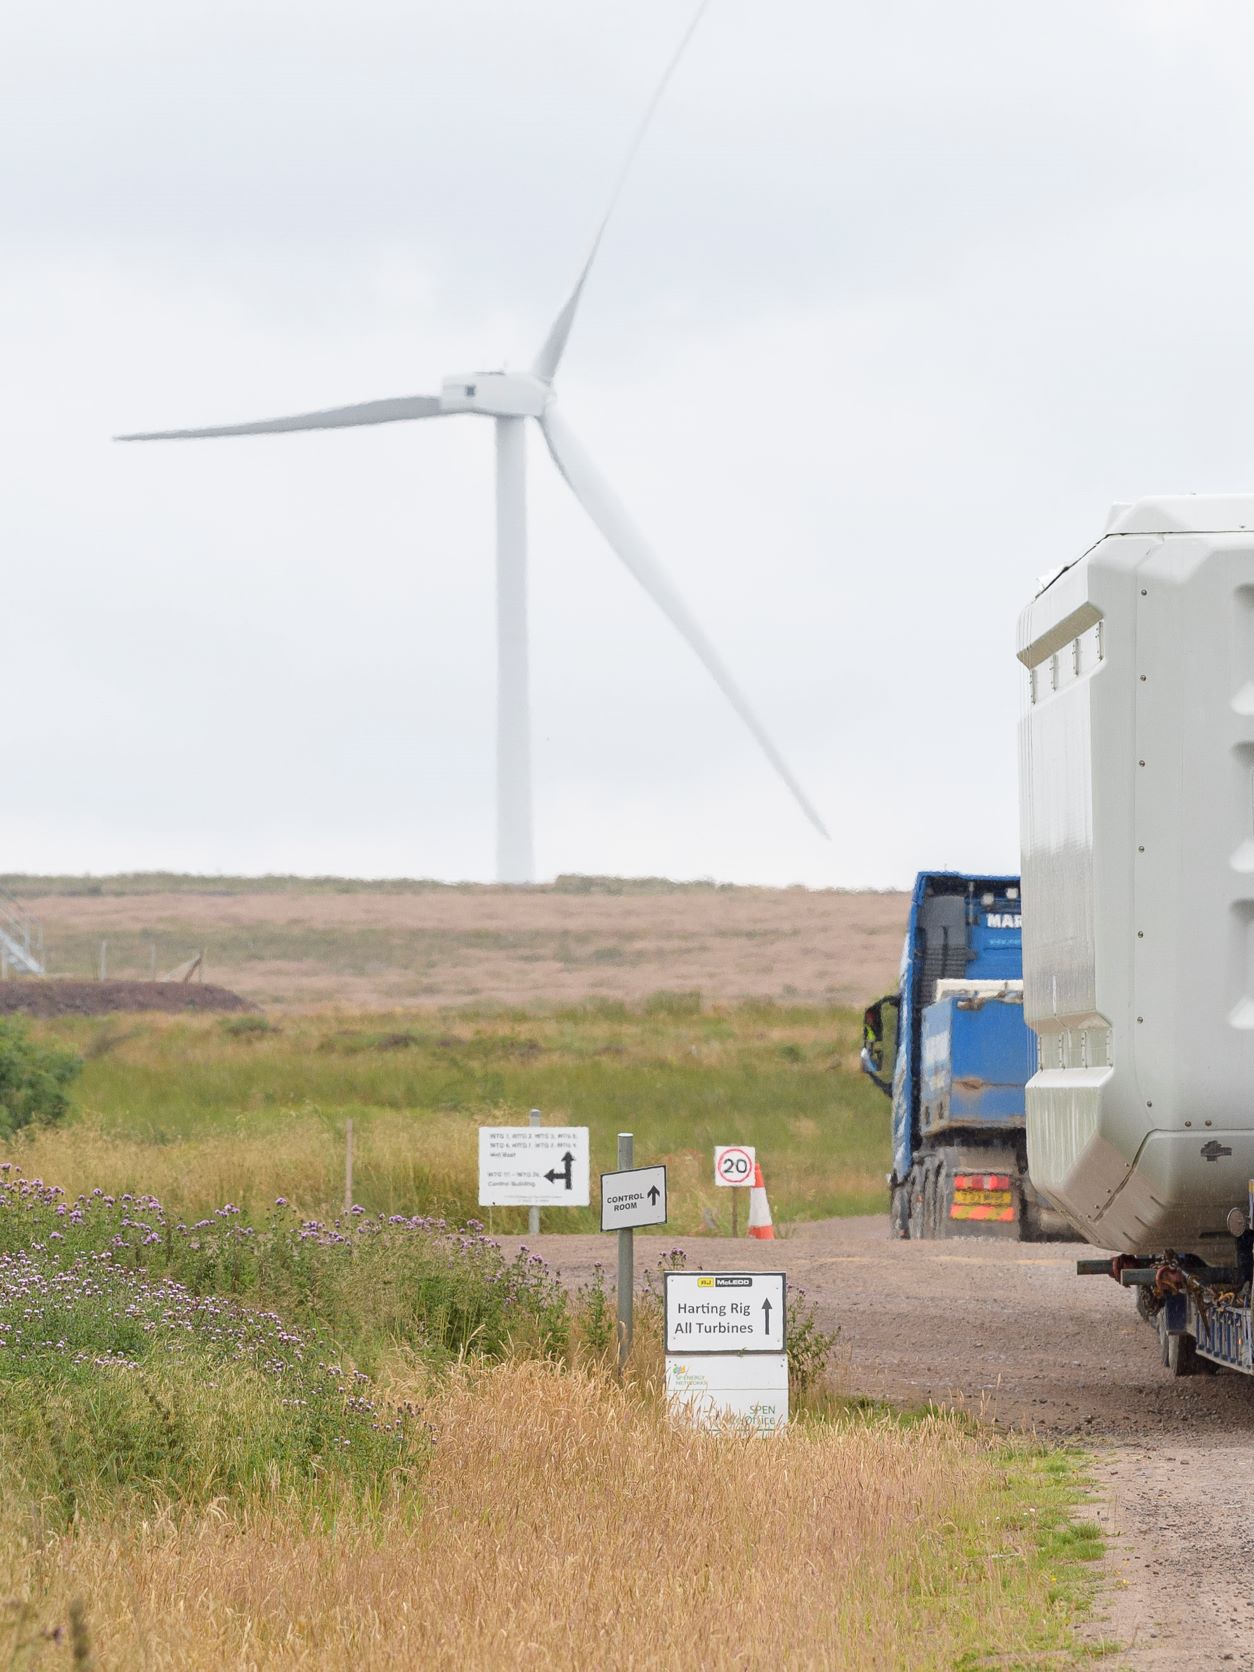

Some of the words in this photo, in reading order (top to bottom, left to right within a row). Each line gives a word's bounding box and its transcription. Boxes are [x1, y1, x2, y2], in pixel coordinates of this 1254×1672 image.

[723, 1158, 748, 1173] 20
[607, 1193, 644, 1203] CONTROL
[614, 1202, 637, 1211] ROOM
[677, 1302, 726, 1317] Harting
[730, 1302, 751, 1317] Rig
[674, 1322, 692, 1334] All
[696, 1322, 754, 1334] Turbines
[750, 1405, 776, 1414] SPEN
